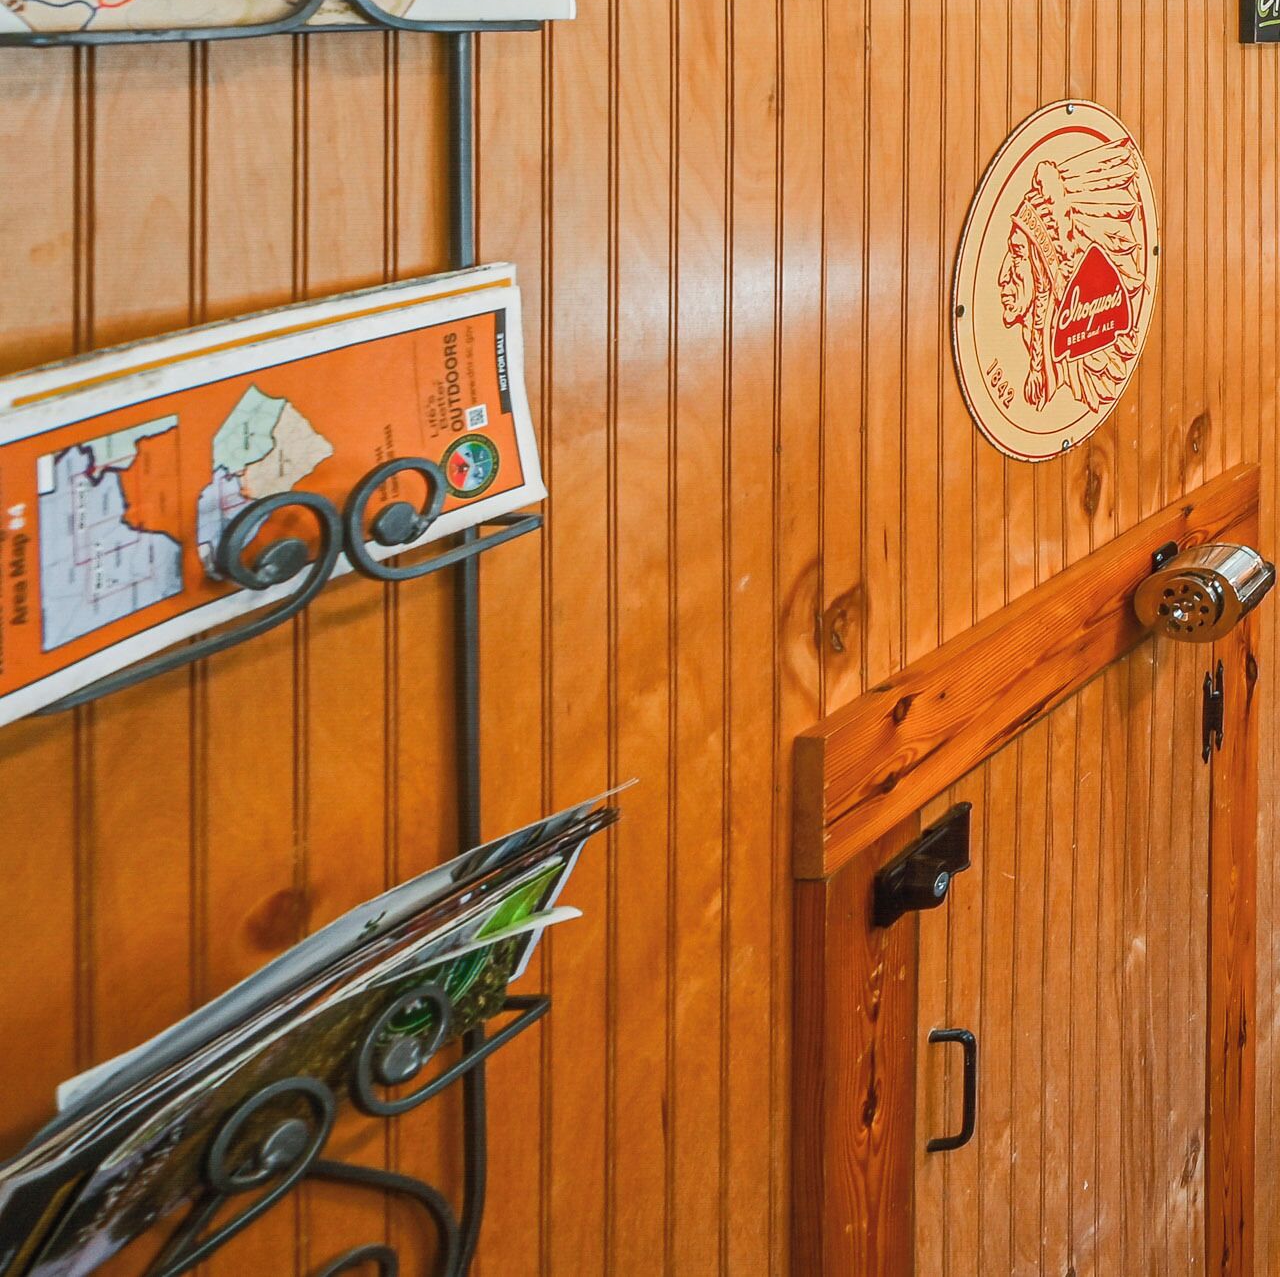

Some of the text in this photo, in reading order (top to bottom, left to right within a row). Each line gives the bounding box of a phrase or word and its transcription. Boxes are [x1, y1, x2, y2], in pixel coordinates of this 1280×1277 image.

[1059, 285, 1122, 331] Iroquois
[1067, 320, 1115, 346] BEER and ALE
[443, 331, 465, 432] OUTDOORS
[496, 333, 507, 391] NOT FOR SALE
[986, 357, 1014, 409] 1842
[9, 533, 30, 577] Map
[10, 580, 28, 625] Area
